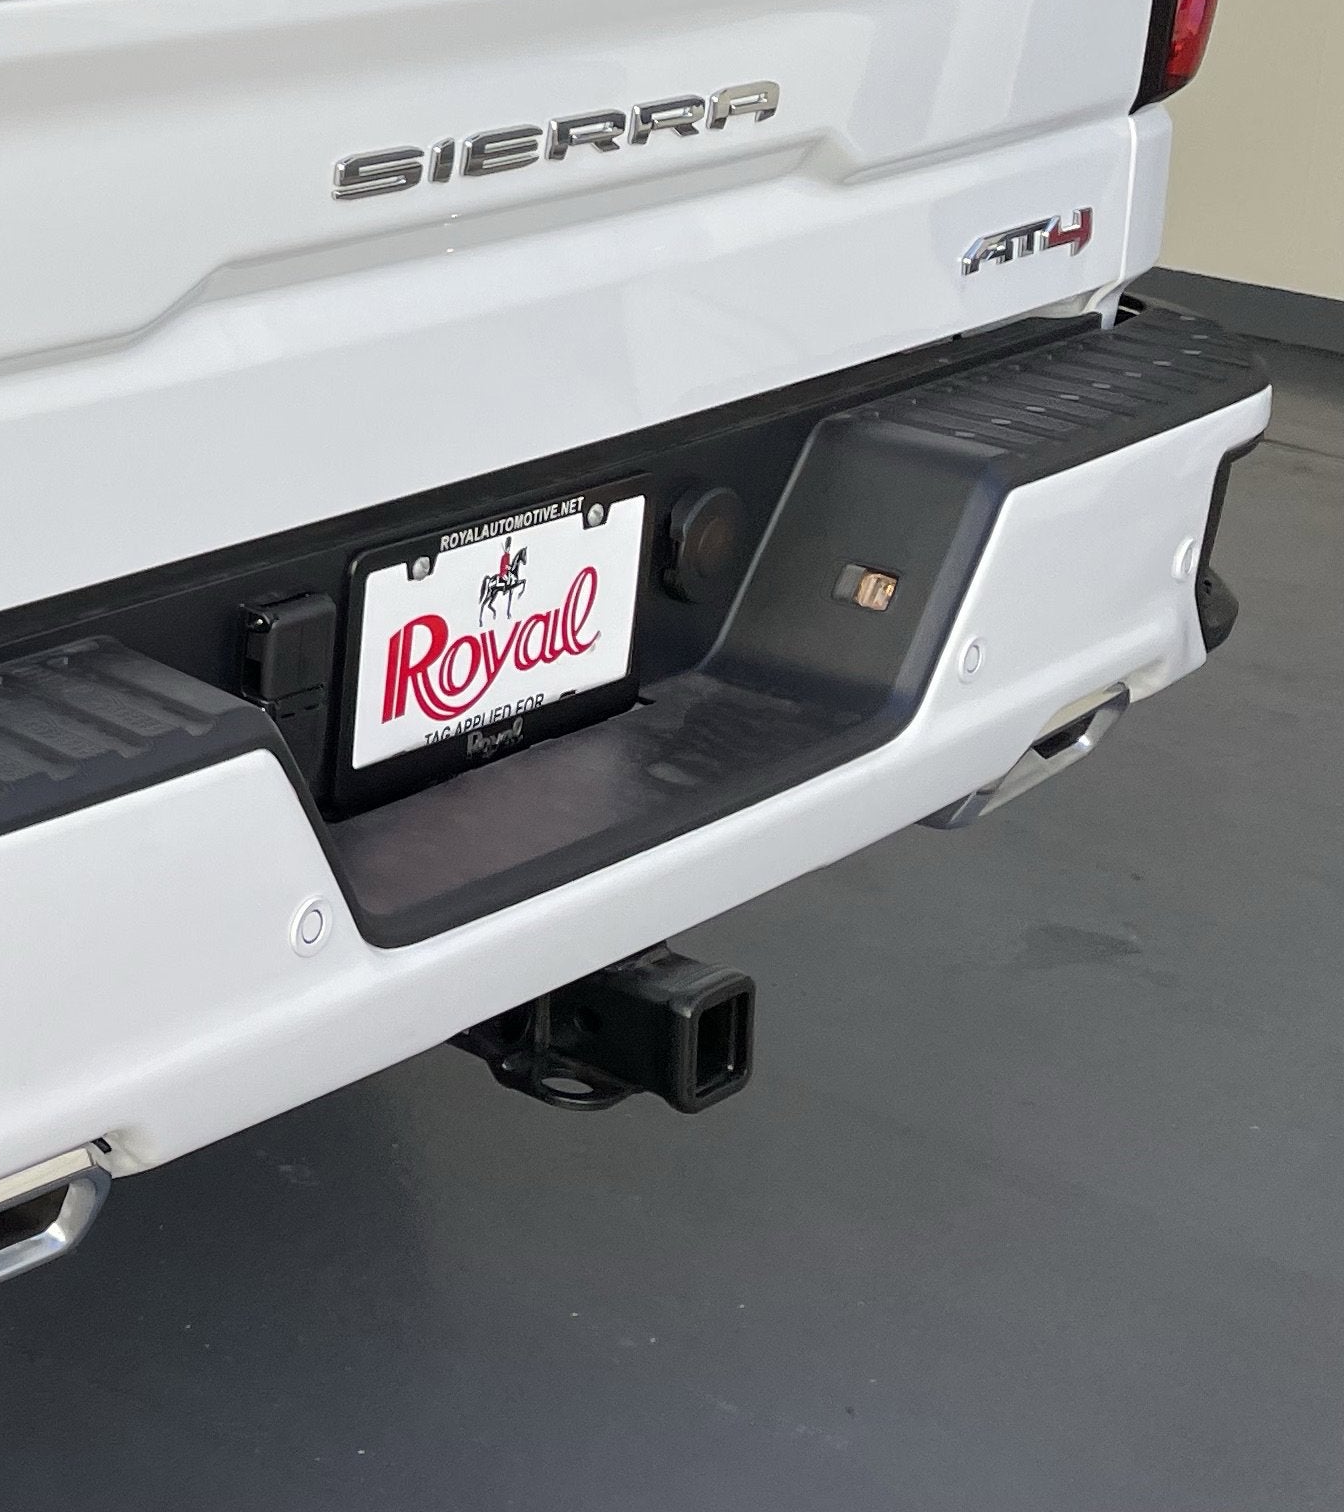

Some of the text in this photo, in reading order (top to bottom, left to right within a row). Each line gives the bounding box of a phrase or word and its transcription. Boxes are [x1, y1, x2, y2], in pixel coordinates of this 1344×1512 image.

[331, 81, 780, 201] SIERRA
[961, 206, 1094, 276] AT4
[440, 496, 585, 552] ROYALAUTOMOTIVE.NET
[381, 566, 602, 724] Royal
[424, 725, 451, 745] TAG
[516, 693, 545, 715] FOR
